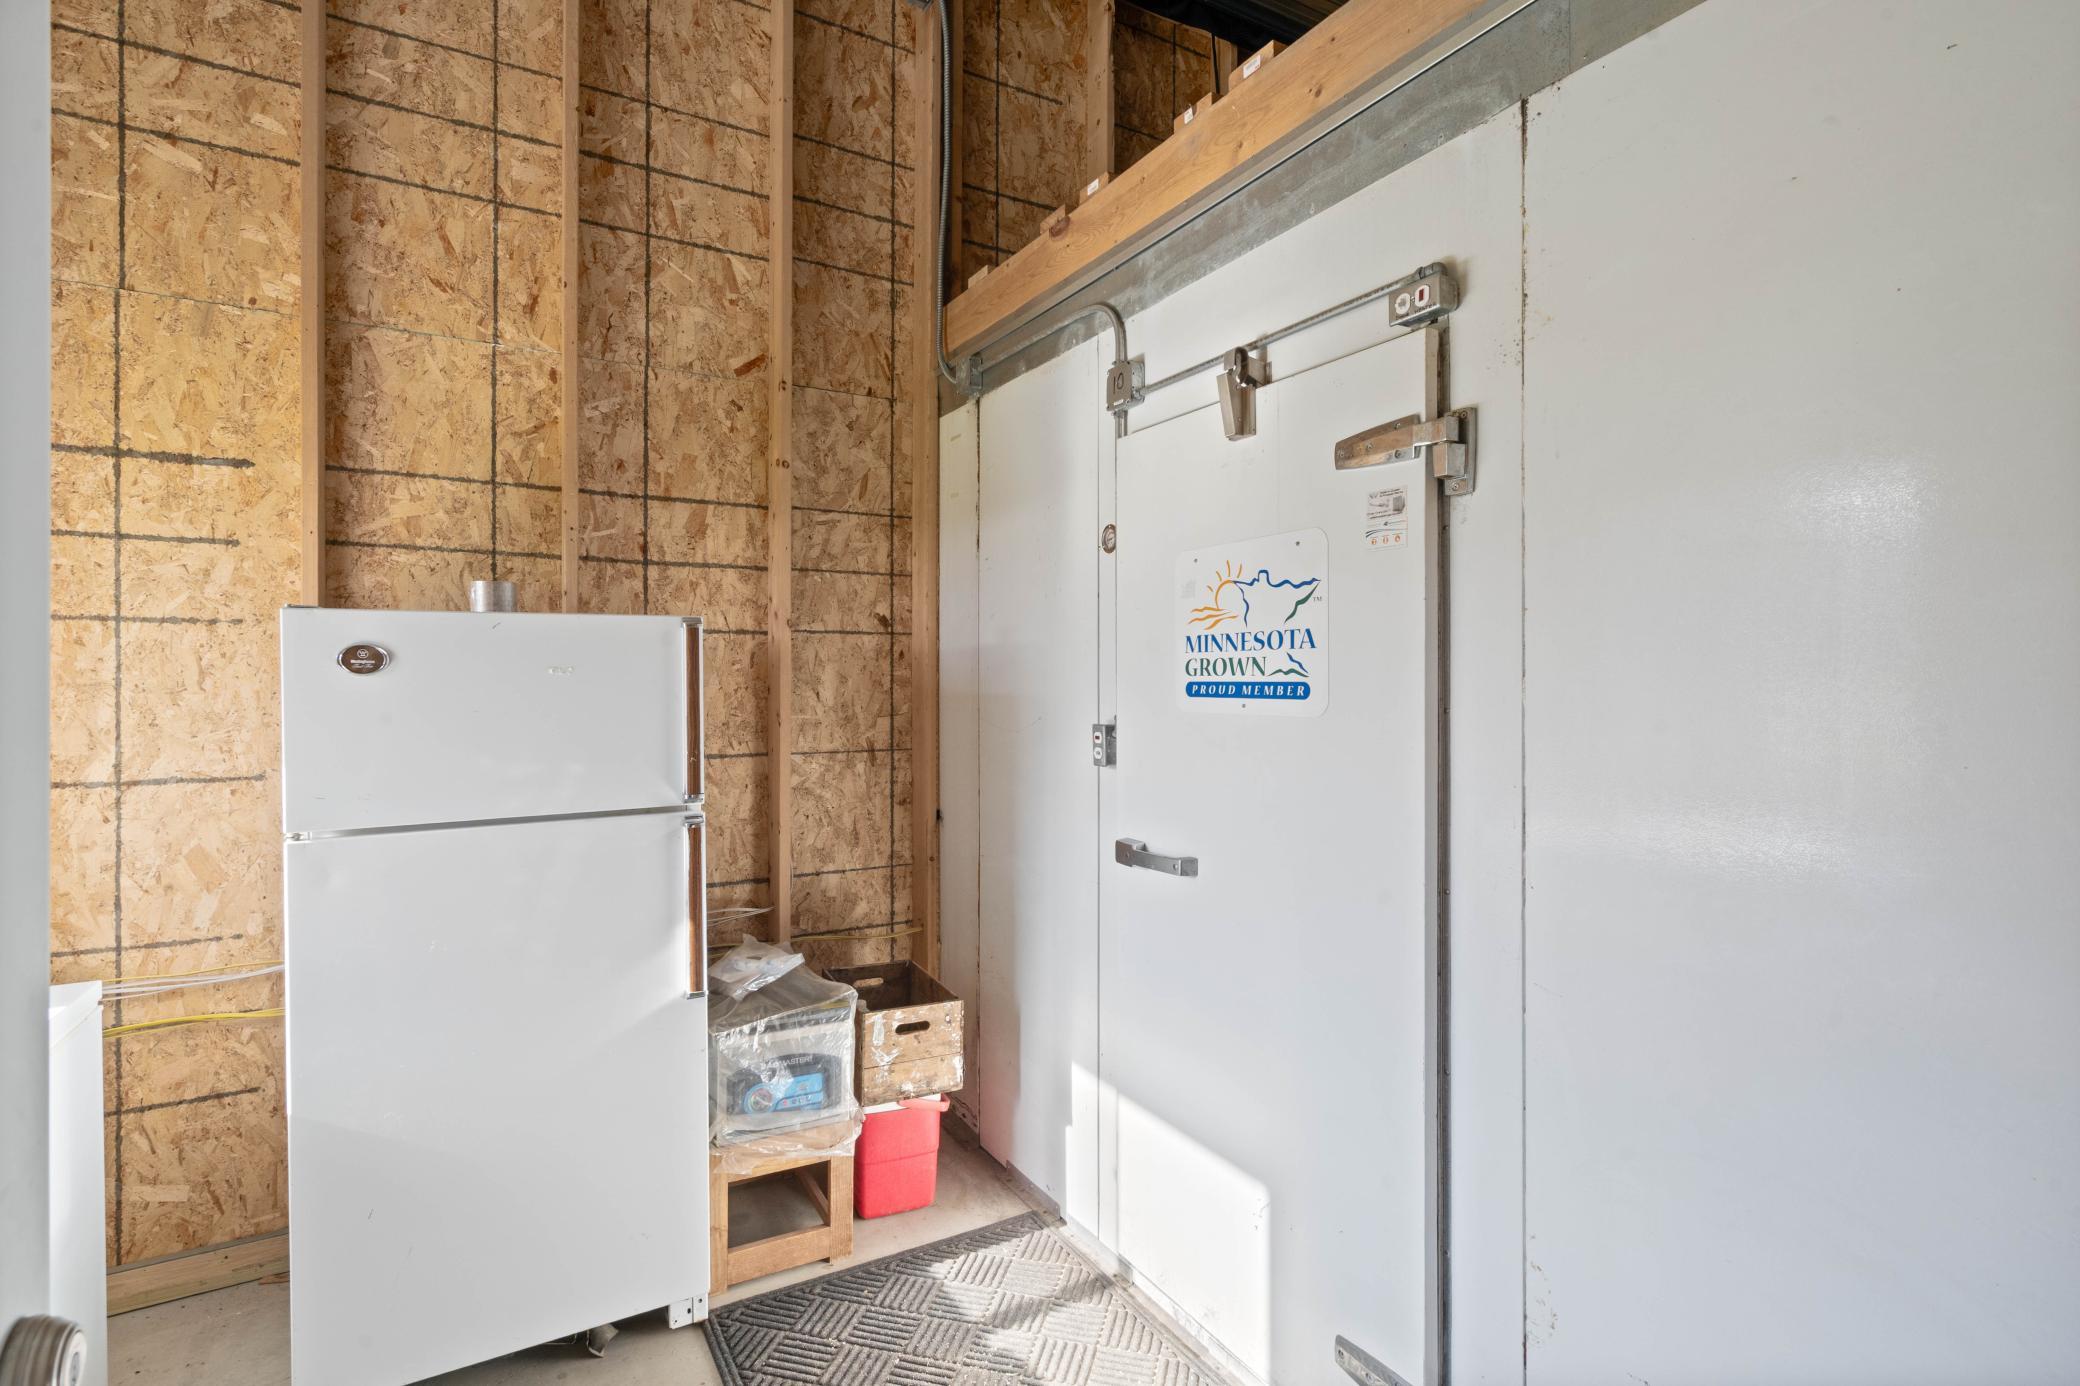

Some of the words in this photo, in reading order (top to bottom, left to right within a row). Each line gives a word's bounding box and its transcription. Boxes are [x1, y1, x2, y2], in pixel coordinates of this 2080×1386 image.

[1185, 628, 1317, 653] MINNESOTA
[1185, 656, 1266, 677] GROWN
[1192, 684, 1236, 695] PROUD
[1241, 685, 1305, 696] MEMBER
